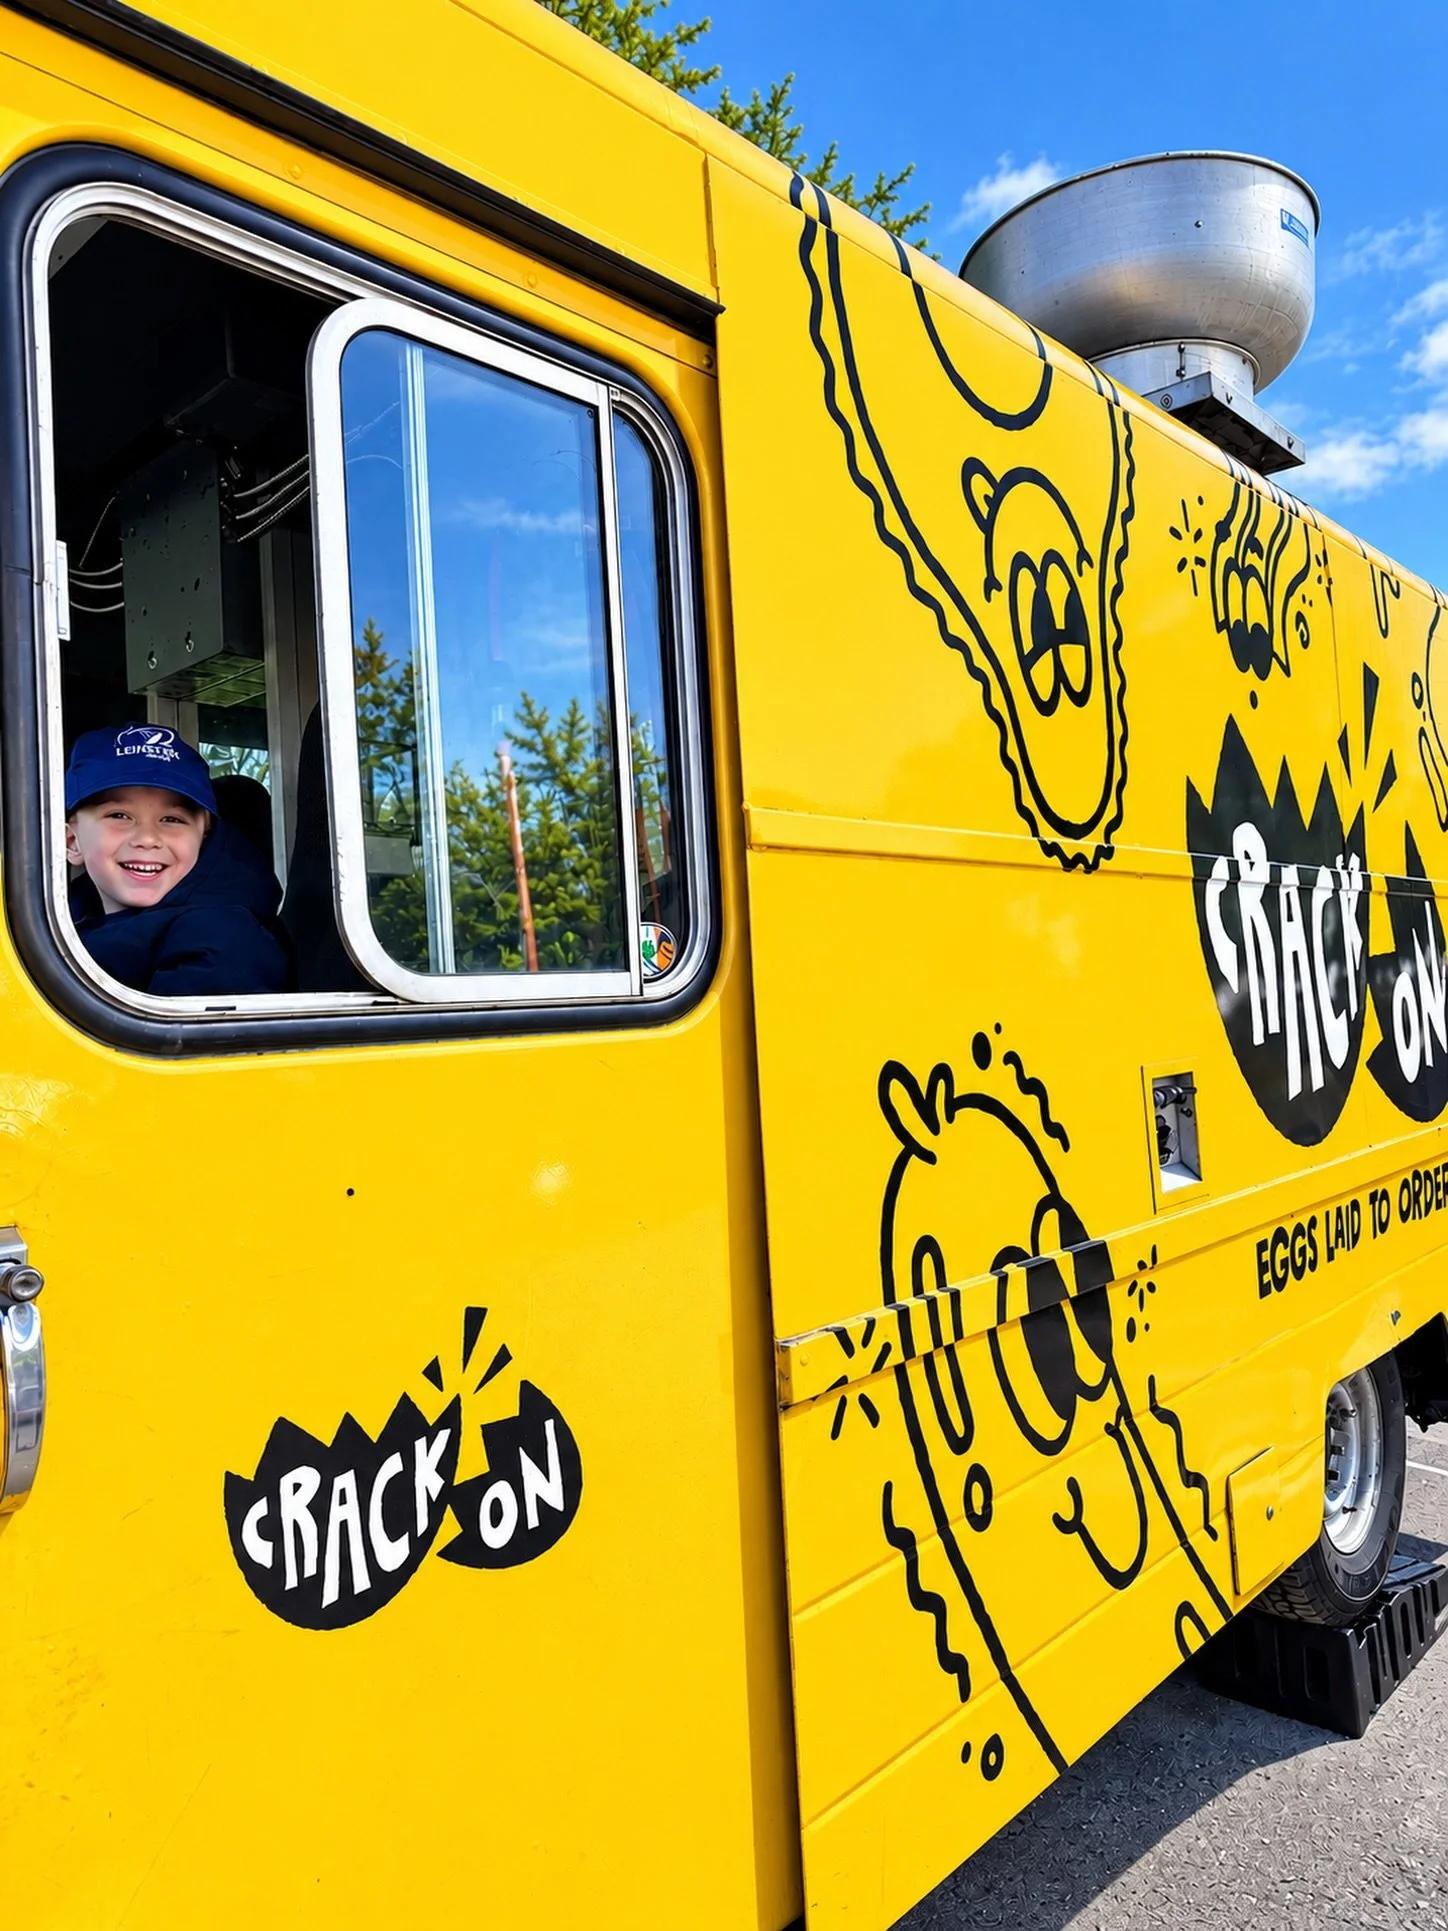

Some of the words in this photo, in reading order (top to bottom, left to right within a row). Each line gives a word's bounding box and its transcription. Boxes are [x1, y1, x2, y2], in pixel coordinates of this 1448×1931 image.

[1205, 821, 1363, 1102] CRACK
[1392, 900, 1448, 1084] ON
[1256, 1215, 1318, 1300] EGGS
[1325, 1199, 1361, 1263] LAID
[1369, 1188, 1391, 1240] TO
[241, 1428, 452, 1609] CRACK
[478, 1418, 565, 1550] ON
